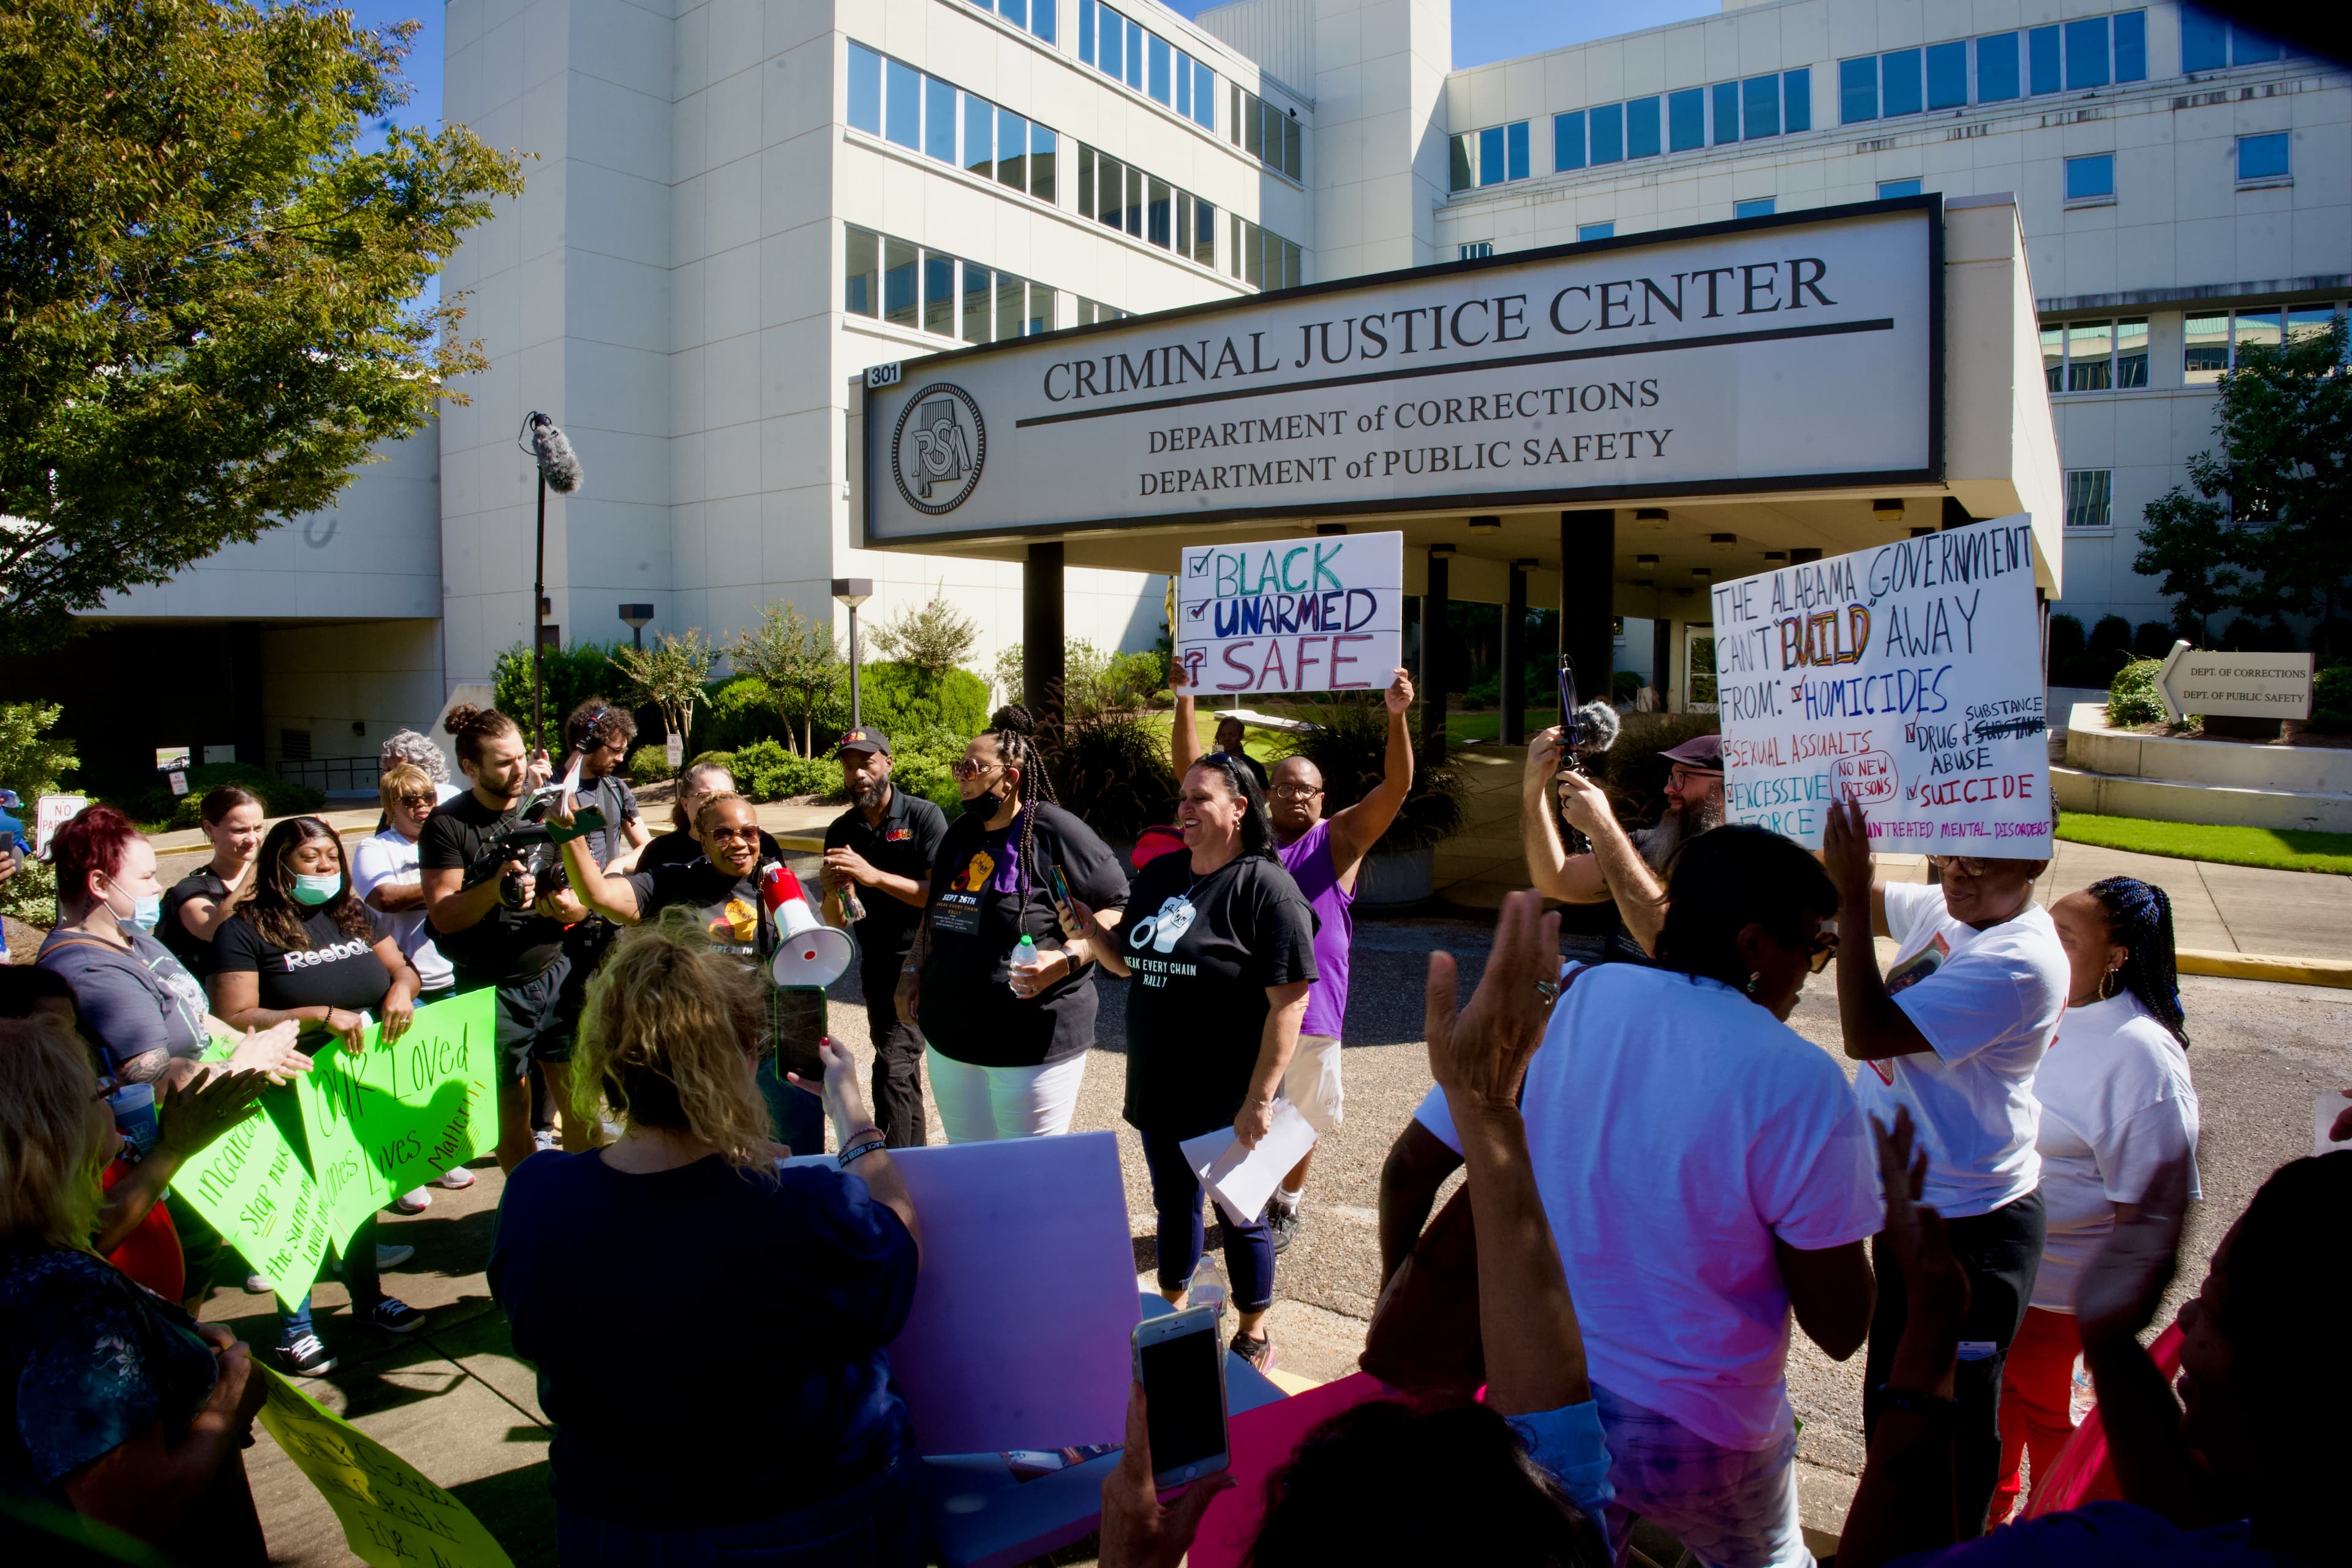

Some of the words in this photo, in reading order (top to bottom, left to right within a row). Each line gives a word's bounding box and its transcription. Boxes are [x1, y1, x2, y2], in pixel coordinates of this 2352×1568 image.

[1043, 331, 1280, 402] CRIMINAL
[1295, 294, 1531, 369] JUSTICE
[1549, 258, 1838, 334] CENTER
[872, 363, 900, 383] 301
[1148, 410, 1348, 454] DEPARTMENT
[1357, 405, 1388, 432] of
[1395, 379, 1660, 428] CORRECTIONS
[911, 418, 972, 477] RSA
[1139, 456, 1337, 496] DEPARTMENT
[1346, 451, 1377, 479] of
[1382, 441, 1511, 476] PUBLIC
[1523, 428, 1675, 466] SAFETY
[1216, 543, 1343, 598] BLACK
[1714, 580, 1758, 625] THE
[1771, 557, 1857, 614] ALABAMA
[1869, 525, 2031, 597] GOVERNMENT
[1215, 588, 1377, 638] UNARMED
[1716, 625, 1771, 674] CAN'T
[1887, 588, 1980, 658] AWAY
[1216, 635, 1373, 691] SAFE
[2190, 668, 2216, 676] DEPT.
[2219, 668, 2232, 677] OF
[2234, 669, 2306, 679] CORRECTIONS
[1720, 680, 1783, 723] FROM:
[1804, 665, 1953, 721] HOMICIDES
[1966, 697, 2043, 721] SUBSTANCE
[2183, 690, 2209, 699] DEPT.
[2212, 692, 2224, 700] OF
[2226, 693, 2262, 701] PUBLIC
[2265, 693, 2305, 703] SAFETY
[1732, 737, 1787, 767] SEXUAL
[1792, 730, 1872, 764] ASSUALTS
[1917, 723, 1958, 753] DRUG
[1838, 761, 1853, 777] NO
[1858, 757, 1887, 777] NEW
[1931, 747, 1992, 775] ABUSE
[1735, 775, 1831, 812] EXCESSIVE
[1841, 777, 1892, 801] PRISONS
[1920, 774, 2034, 807] SUICIDE
[55, 805, 71, 816] NO
[886, 829, 913, 842] WAR
[1866, 821, 1934, 839] UNTREATED
[1941, 821, 1992, 838] MENTAL
[1994, 821, 2051, 840] DISORDERS
[942, 894, 958, 902] SEPT
[959, 895, 976, 905] 26TH
[284, 937, 373, 972] Reebok
[1142, 959, 1167, 973] EVERY
[1170, 963, 1197, 976] CHAIN
[1143, 974, 1167, 987] RALLY
[362, 1129, 421, 1196] Lives
